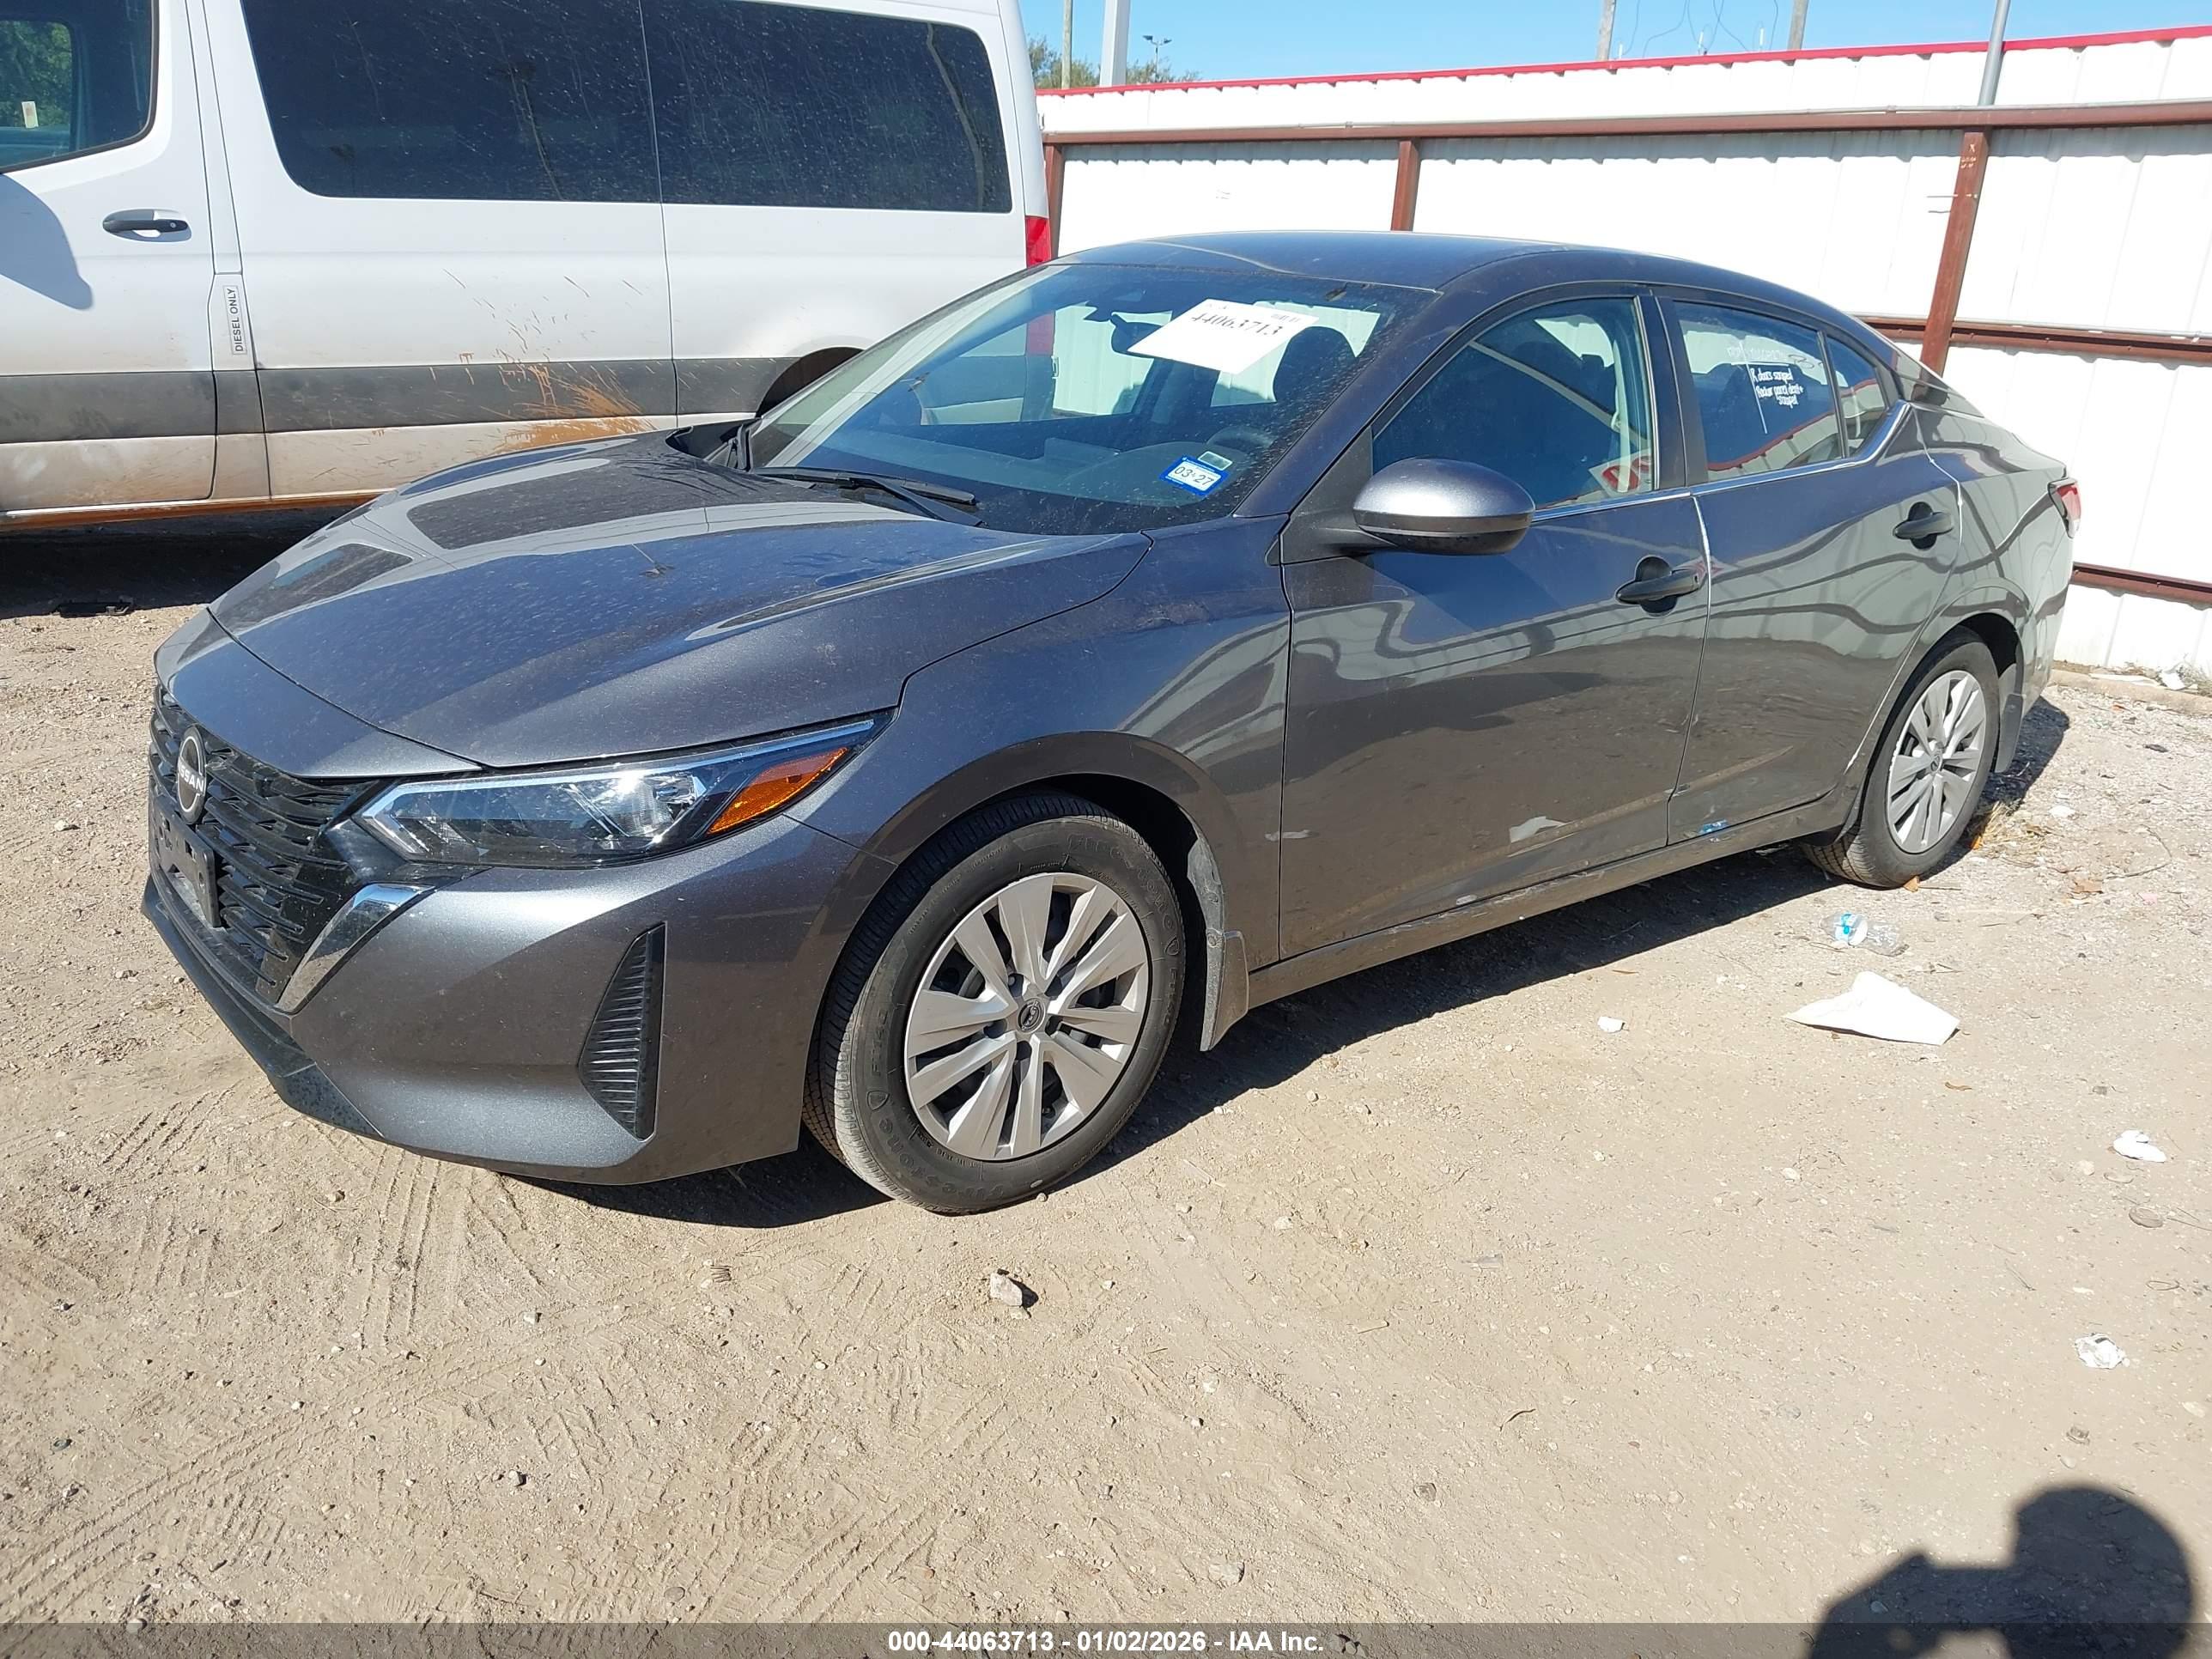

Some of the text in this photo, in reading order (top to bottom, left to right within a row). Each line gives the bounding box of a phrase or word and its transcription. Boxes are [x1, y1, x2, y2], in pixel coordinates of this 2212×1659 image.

[227, 288, 243, 351] DIESEL ONLY
[1191, 313, 1283, 336] 44063713
[1174, 466, 1194, 477] 03
[1193, 474, 1215, 486] 27
